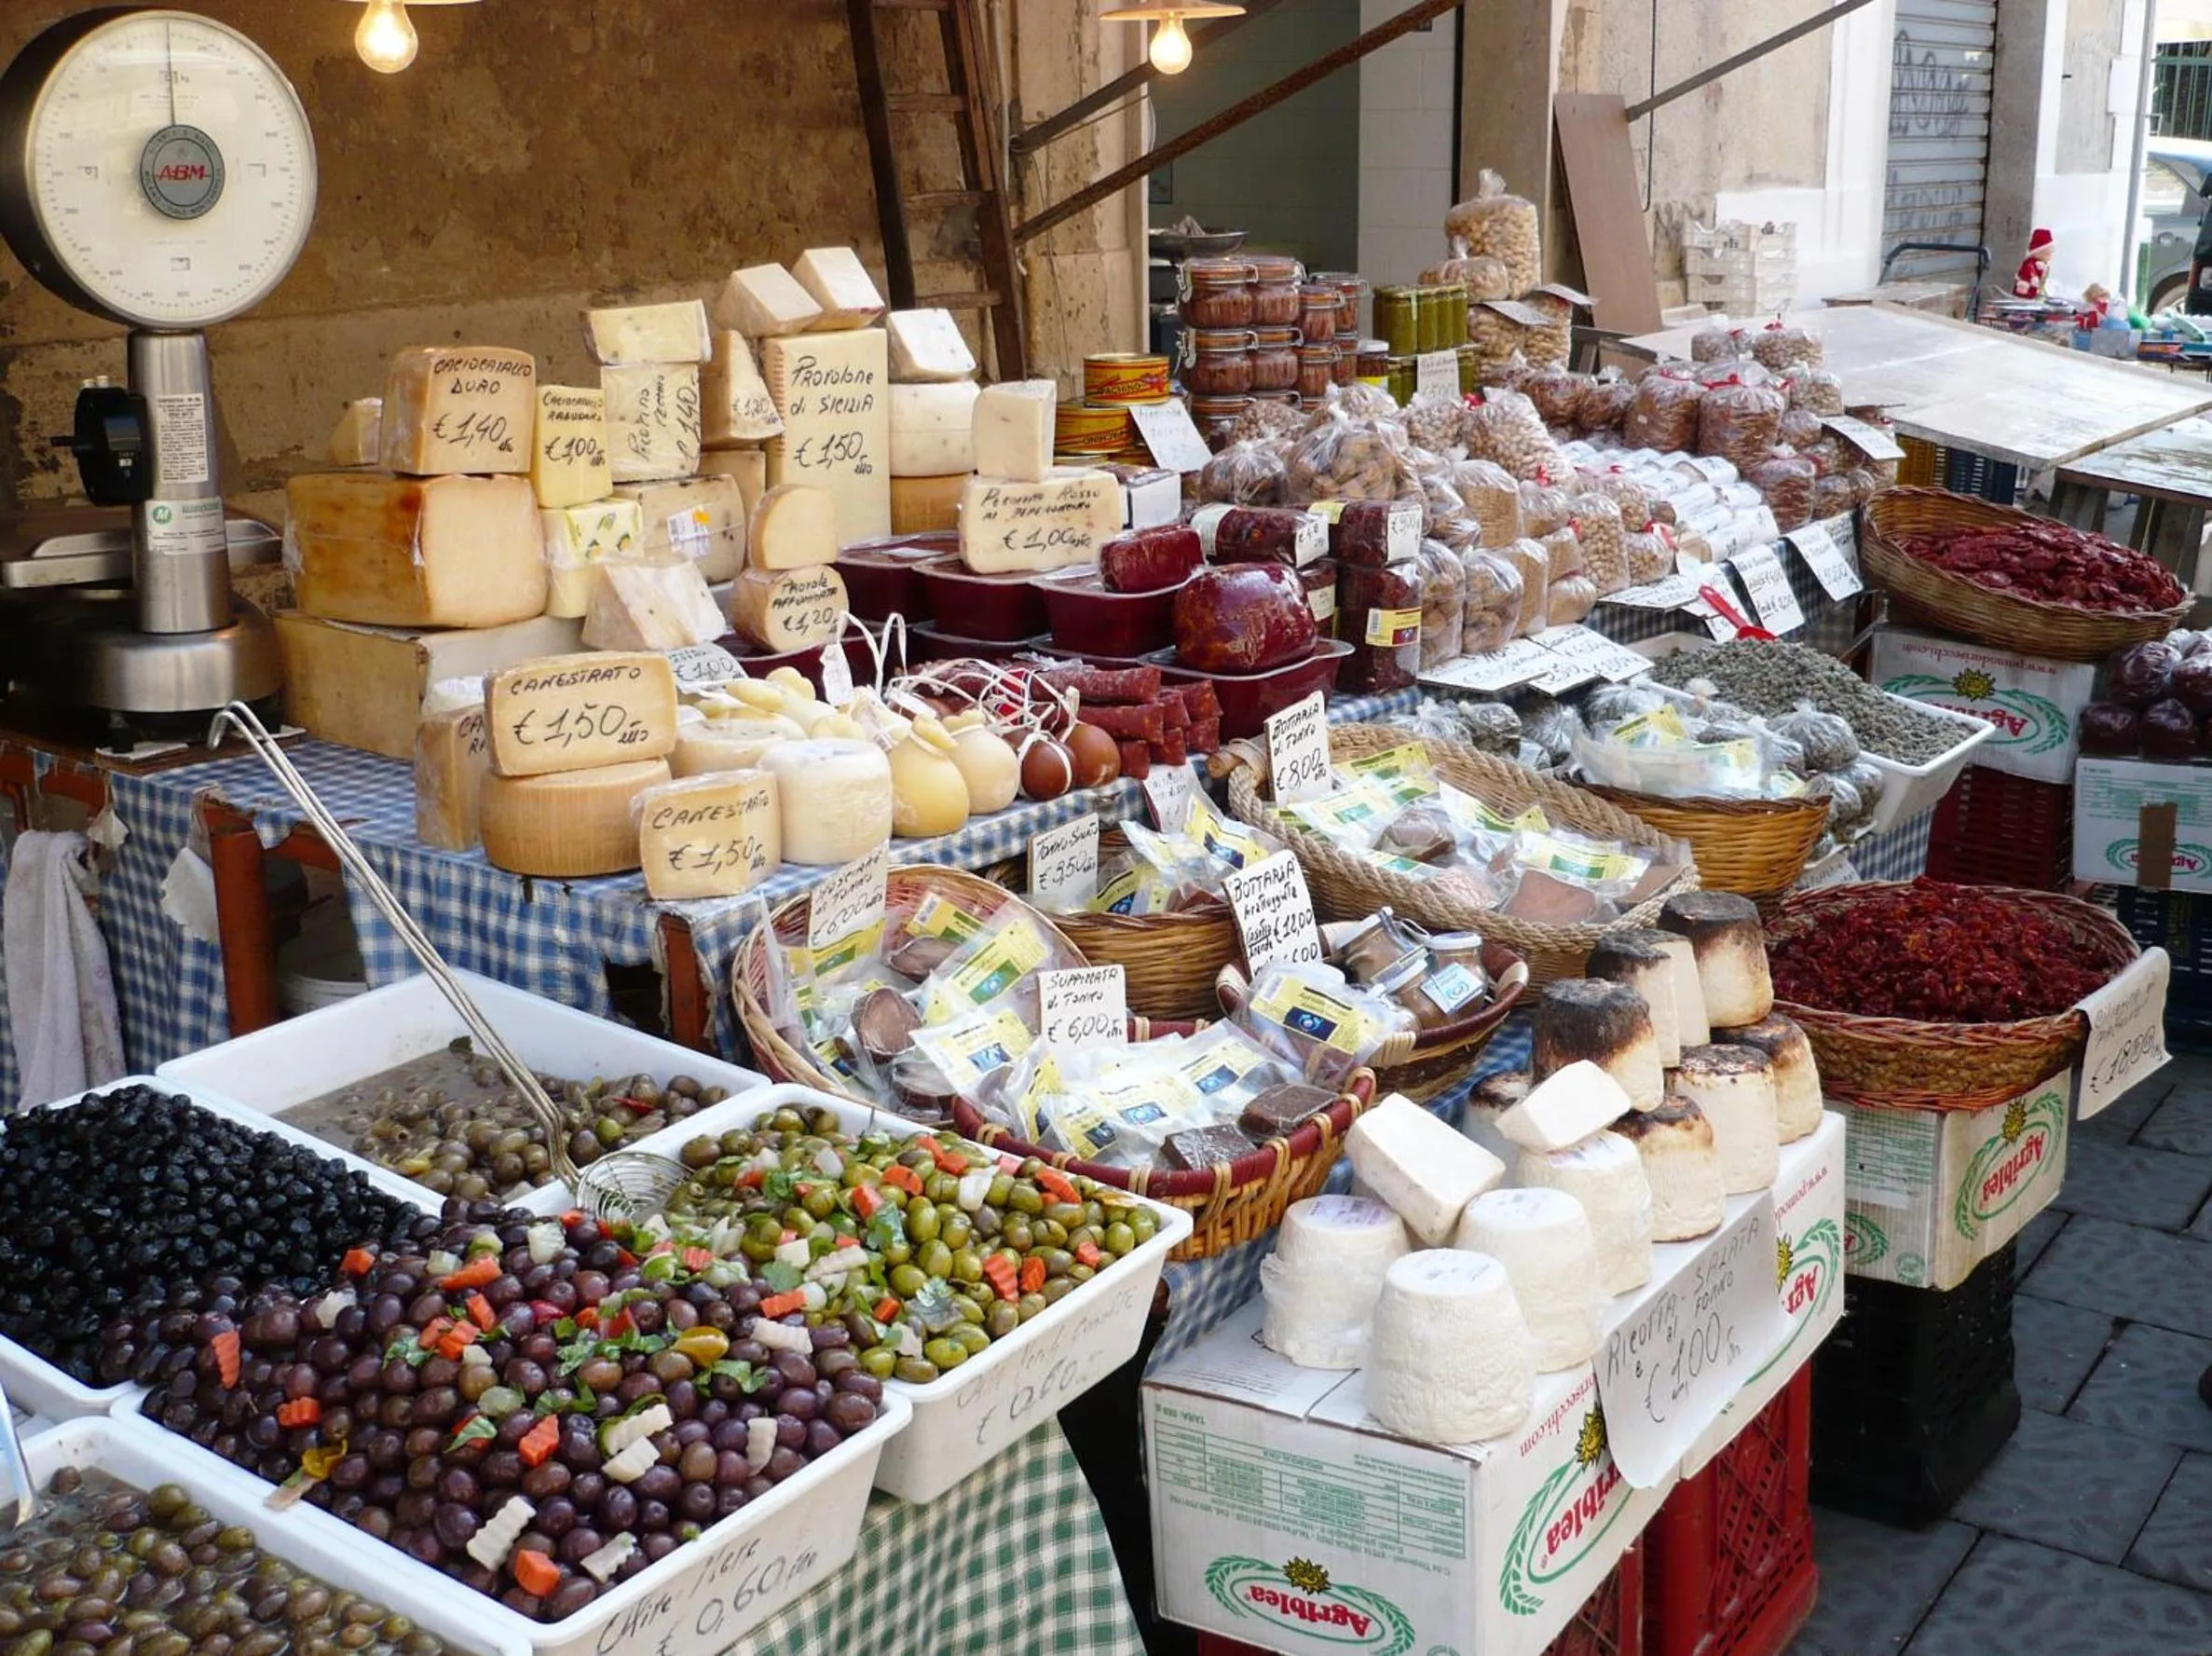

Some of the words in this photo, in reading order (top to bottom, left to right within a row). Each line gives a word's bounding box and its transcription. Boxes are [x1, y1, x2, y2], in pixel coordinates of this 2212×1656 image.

[157, 164, 206, 181] ABM
[451, 377, 501, 395] DURO
[432, 413, 451, 440] €
[448, 411, 508, 450] 1,40
[544, 436, 561, 462] €
[561, 437, 597, 466] 1,00
[794, 437, 814, 468] €
[816, 431, 864, 471] 1,50
[1003, 528, 1018, 551] €
[1023, 527, 1074, 552] 1,00
[511, 665, 642, 695] CANESTRATO
[676, 664, 692, 682] €
[692, 657, 734, 681] 1,00
[512, 709, 536, 746] €
[543, 703, 627, 748] 1,50
[652, 790, 769, 829] CANESTRATO
[668, 843, 692, 870] €
[691, 835, 755, 875] 1,50
[1039, 867, 1051, 890] €
[1047, 1018, 1062, 1044] €
[1067, 1012, 1109, 1045] 6,00
[1981, 1130, 2047, 1201] Agriblea
[1644, 1362, 1666, 1424] €
[696, 1554, 786, 1635] 0,60
[1249, 1583, 1372, 1638] Agriblea
